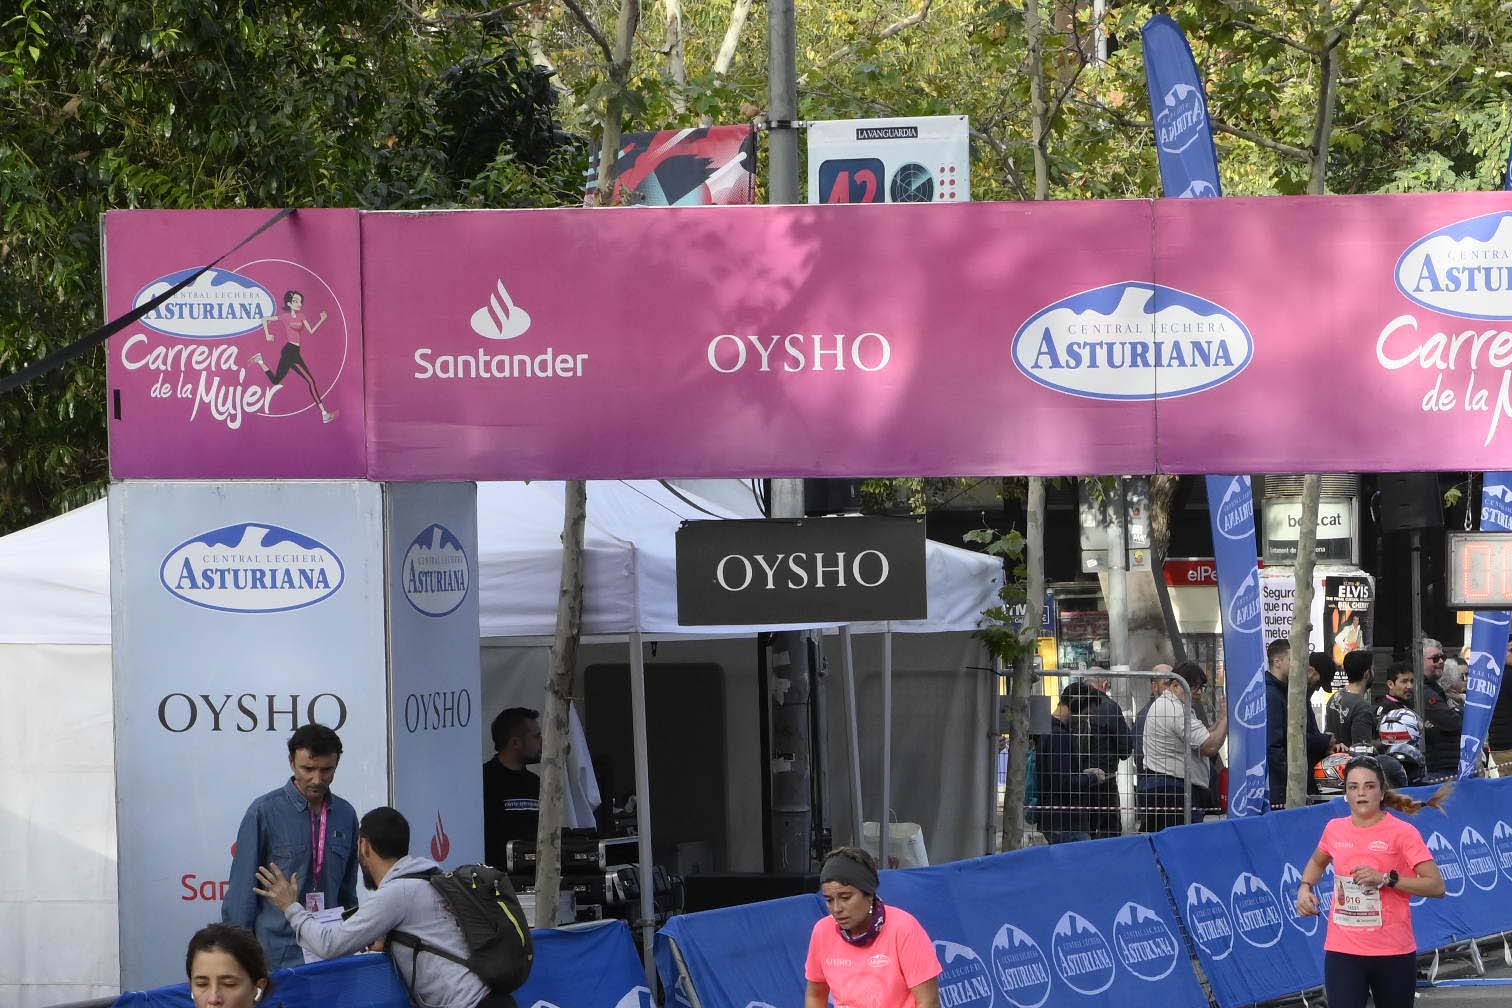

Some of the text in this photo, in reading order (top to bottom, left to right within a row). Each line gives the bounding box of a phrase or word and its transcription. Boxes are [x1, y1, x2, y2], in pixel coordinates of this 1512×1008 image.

[1067, 321, 1227, 336] CENTRAL LECHERA
[120, 333, 238, 371] Carrera
[414, 347, 589, 379] Santander
[706, 332, 892, 374] OYSHO
[1030, 326, 1234, 371] ASTURIANA
[150, 367, 284, 430] de la Mujer
[1421, 371, 1456, 413] de
[1464, 370, 1490, 412] la
[174, 555, 332, 591] ASTURIANA
[202, 553, 325, 564] CENTRAL LECHERA
[715, 549, 890, 592] OYSHO
[407, 559, 466, 595] ASTURIANA
[1338, 585, 1370, 599] ELVIS
[1264, 602, 1280, 613] que
[158, 692, 348, 733] OYSHO
[405, 688, 471, 734] OYSHO
[996, 959, 1049, 992] ASTURIANA
[1057, 945, 1112, 978] ASTURIANA
